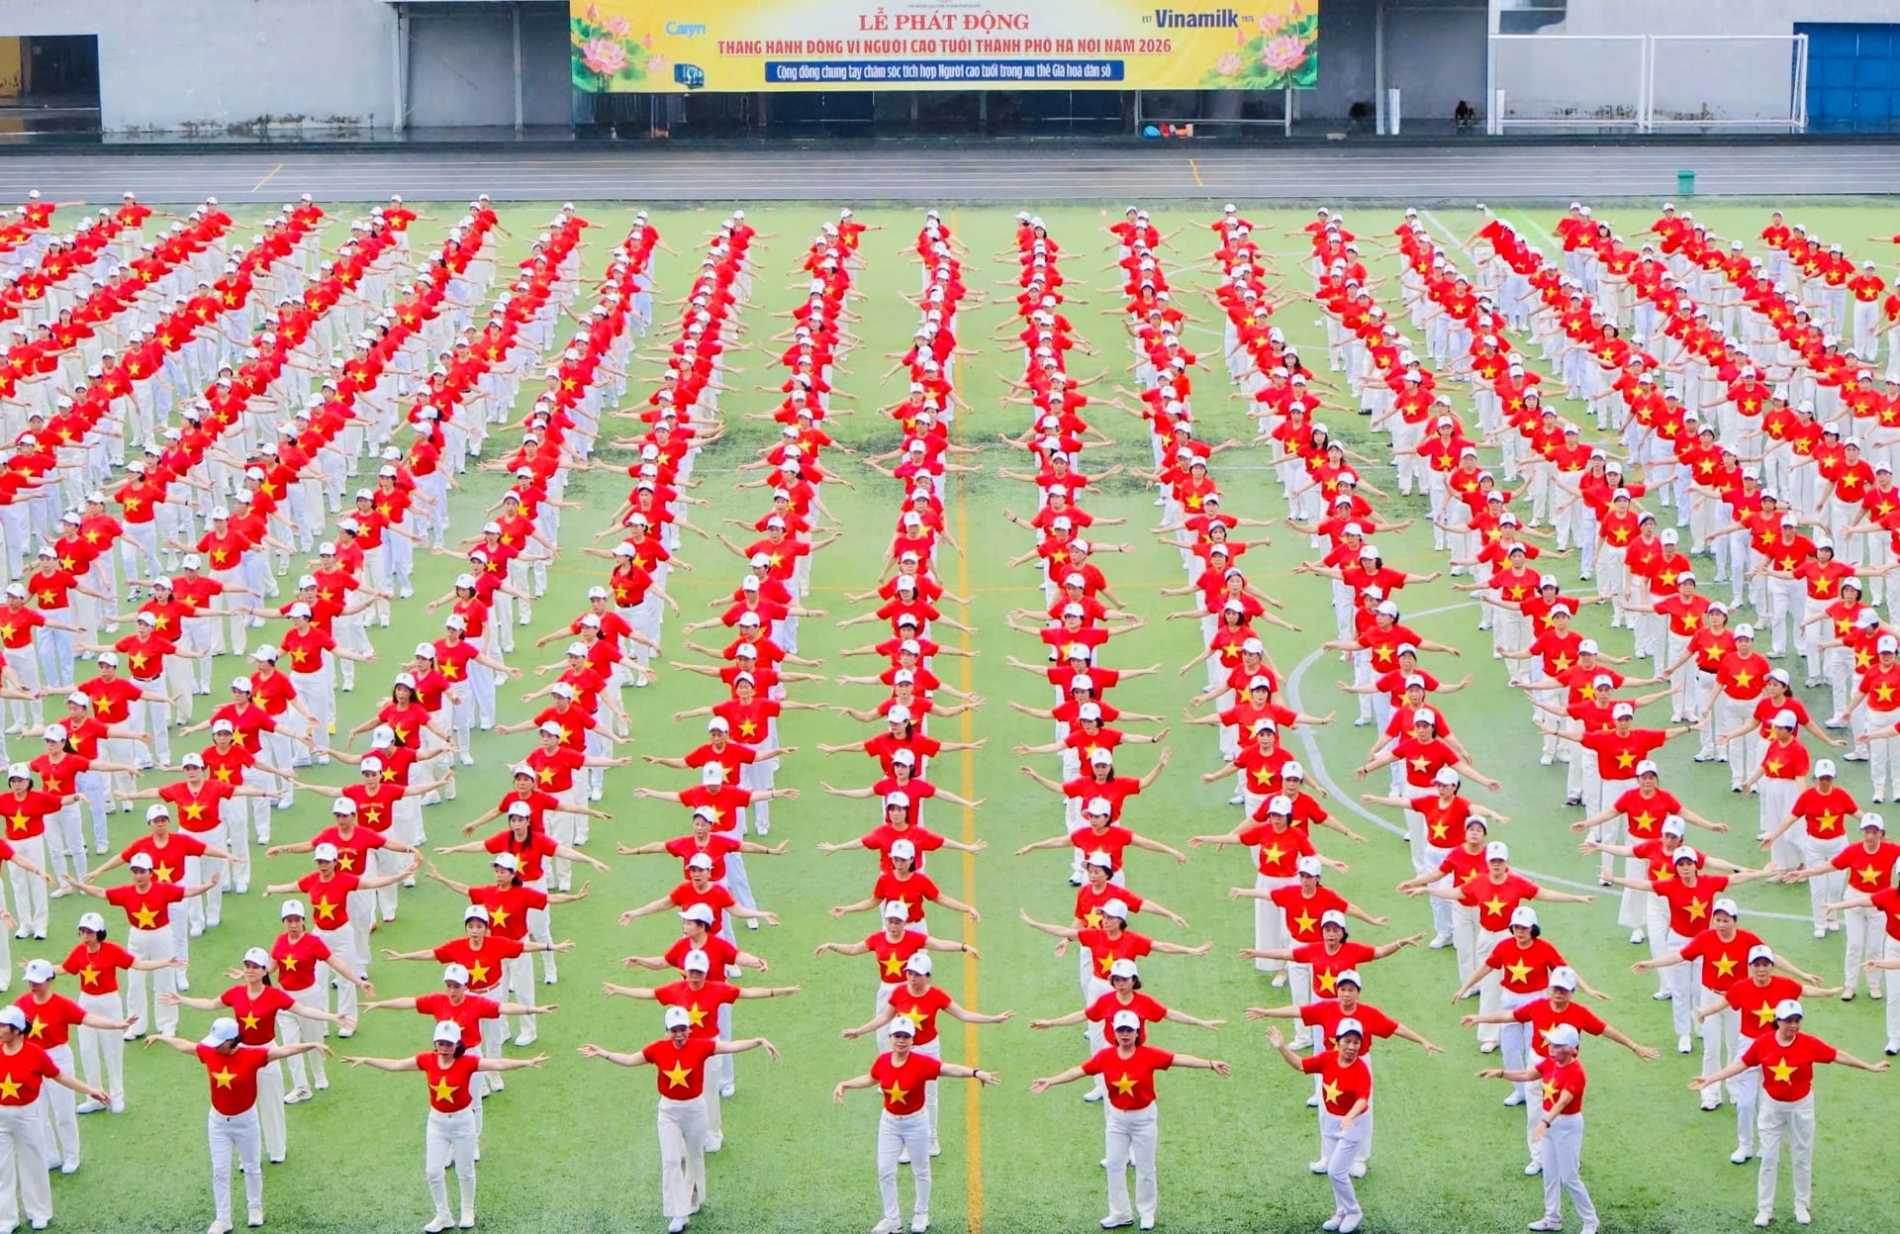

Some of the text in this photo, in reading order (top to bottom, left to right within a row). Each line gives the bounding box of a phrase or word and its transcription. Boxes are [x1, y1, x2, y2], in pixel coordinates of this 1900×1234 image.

[859, 7, 1030, 34] LỄ PHÁT ĐỘNG
[1155, 9, 1239, 28] Vinamilk
[911, 40, 936, 53] CAO
[1139, 40, 1172, 53] 2026
[821, 64, 847, 80] chung
[848, 64, 862, 80] tay
[965, 64, 980, 78] cao
[1024, 64, 1035, 78] xu
